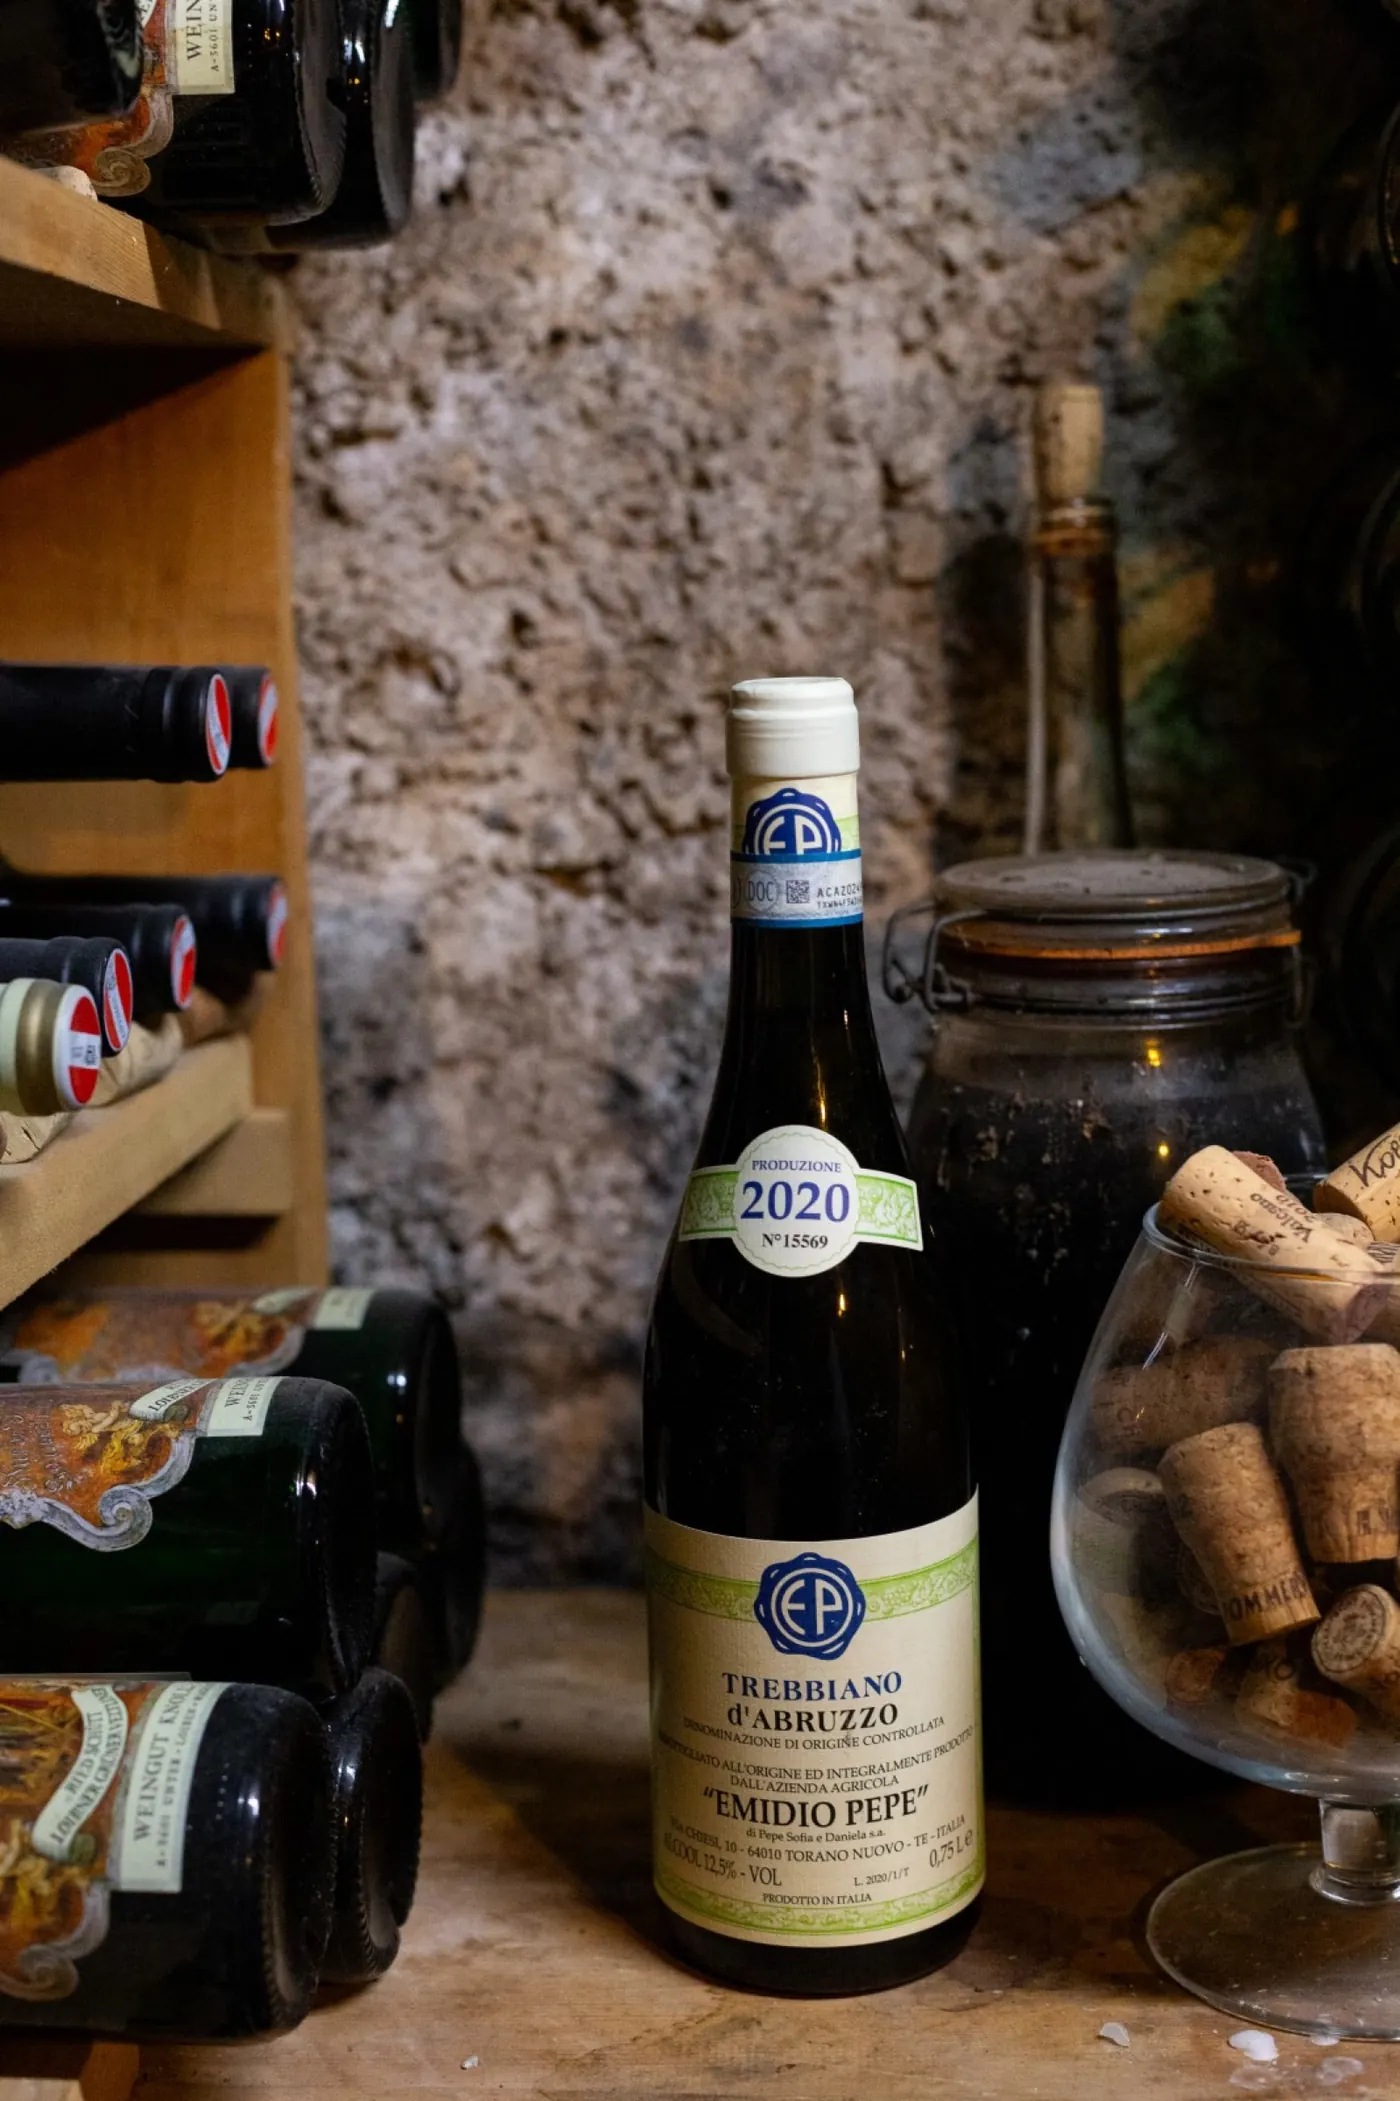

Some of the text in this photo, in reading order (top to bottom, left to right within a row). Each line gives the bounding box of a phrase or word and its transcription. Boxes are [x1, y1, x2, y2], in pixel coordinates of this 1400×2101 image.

[748, 880, 774, 902] DOC
[752, 1160, 842, 1173] PRODUZIONE
[740, 1181, 850, 1222] 2020
[781, 1578, 843, 1636] EP
[722, 1671, 902, 1702] TREBBIANO
[727, 1702, 898, 1732] d'ABRUZZO
[683, 1716, 945, 1750] DENOMINAZIONE DI ORIGINE CONTROLLATA
[722, 1760, 802, 1780] ALL'ORIGINE
[805, 1769, 824, 1780] ED
[827, 1749, 932, 1780] INTEGRALMENTE
[134, 1733, 169, 1841] WEINGUT
[731, 1774, 900, 1794] DALL'AZIENDA AGRICOLA
[725, 1840, 738, 1854] 10
[747, 1845, 782, 1861] 64010
[785, 1848, 849, 1863] TORANO
[852, 1840, 905, 1860] NUOVO
[914, 1832, 928, 1847] TE
[746, 1827, 756, 1838] di
[759, 1829, 784, 1843] Pepe
[786, 1831, 814, 1843] Sofia
[816, 1834, 823, 1843] e
[826, 1829, 867, 1843] Daniela
[749, 1864, 783, 1886] VOL
[929, 1840, 955, 1869] 0,75
[762, 1893, 872, 1906] PRODOTTO IN ITALIA
